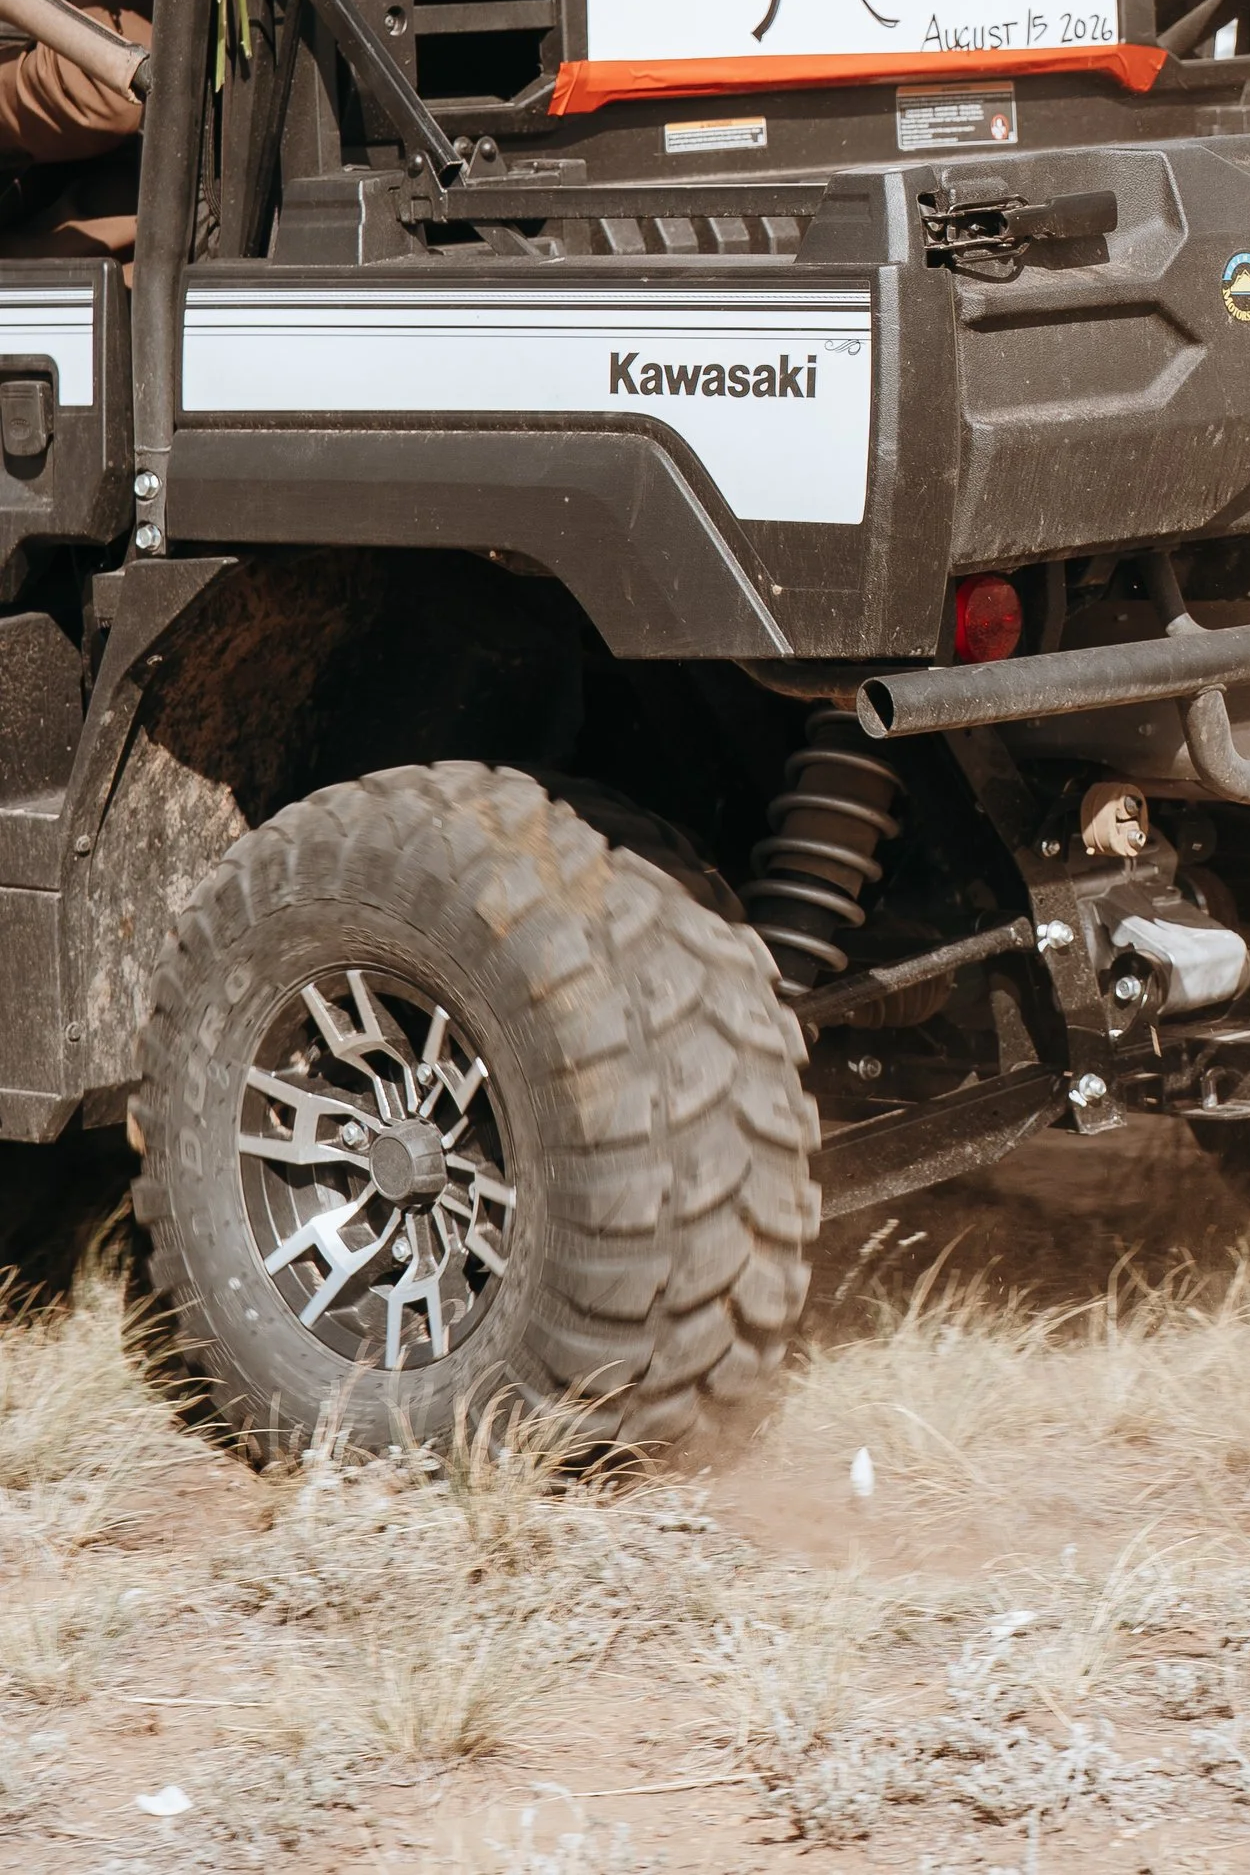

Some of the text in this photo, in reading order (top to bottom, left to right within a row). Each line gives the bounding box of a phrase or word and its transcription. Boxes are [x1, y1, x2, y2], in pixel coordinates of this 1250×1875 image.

[1026, 8, 1048, 46] 15
[1060, 13, 1113, 43] 2026
[609, 351, 818, 399] Kawasaki
